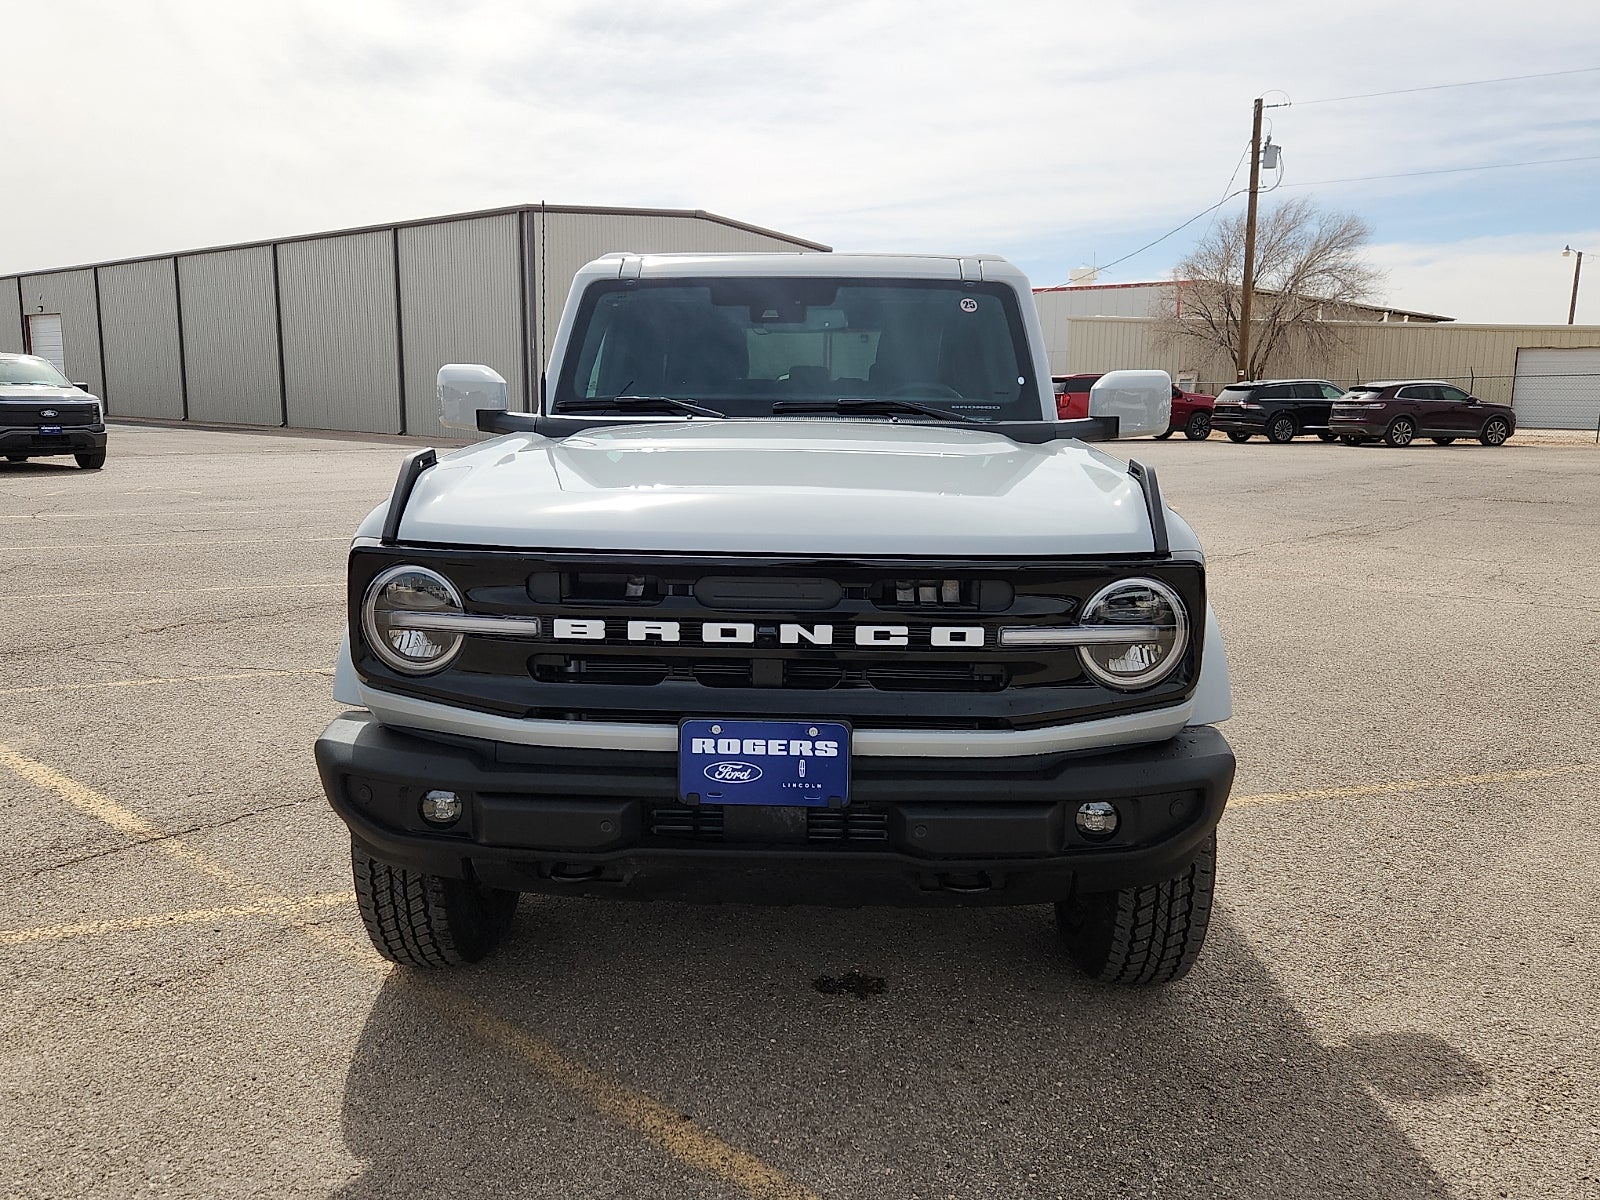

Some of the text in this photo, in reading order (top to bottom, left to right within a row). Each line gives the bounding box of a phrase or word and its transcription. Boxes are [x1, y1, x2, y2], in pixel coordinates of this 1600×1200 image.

[962, 300, 976, 309] 25
[553, 618, 986, 646] BRONCO
[691, 737, 839, 757] ROGERS
[714, 763, 752, 780] Ford
